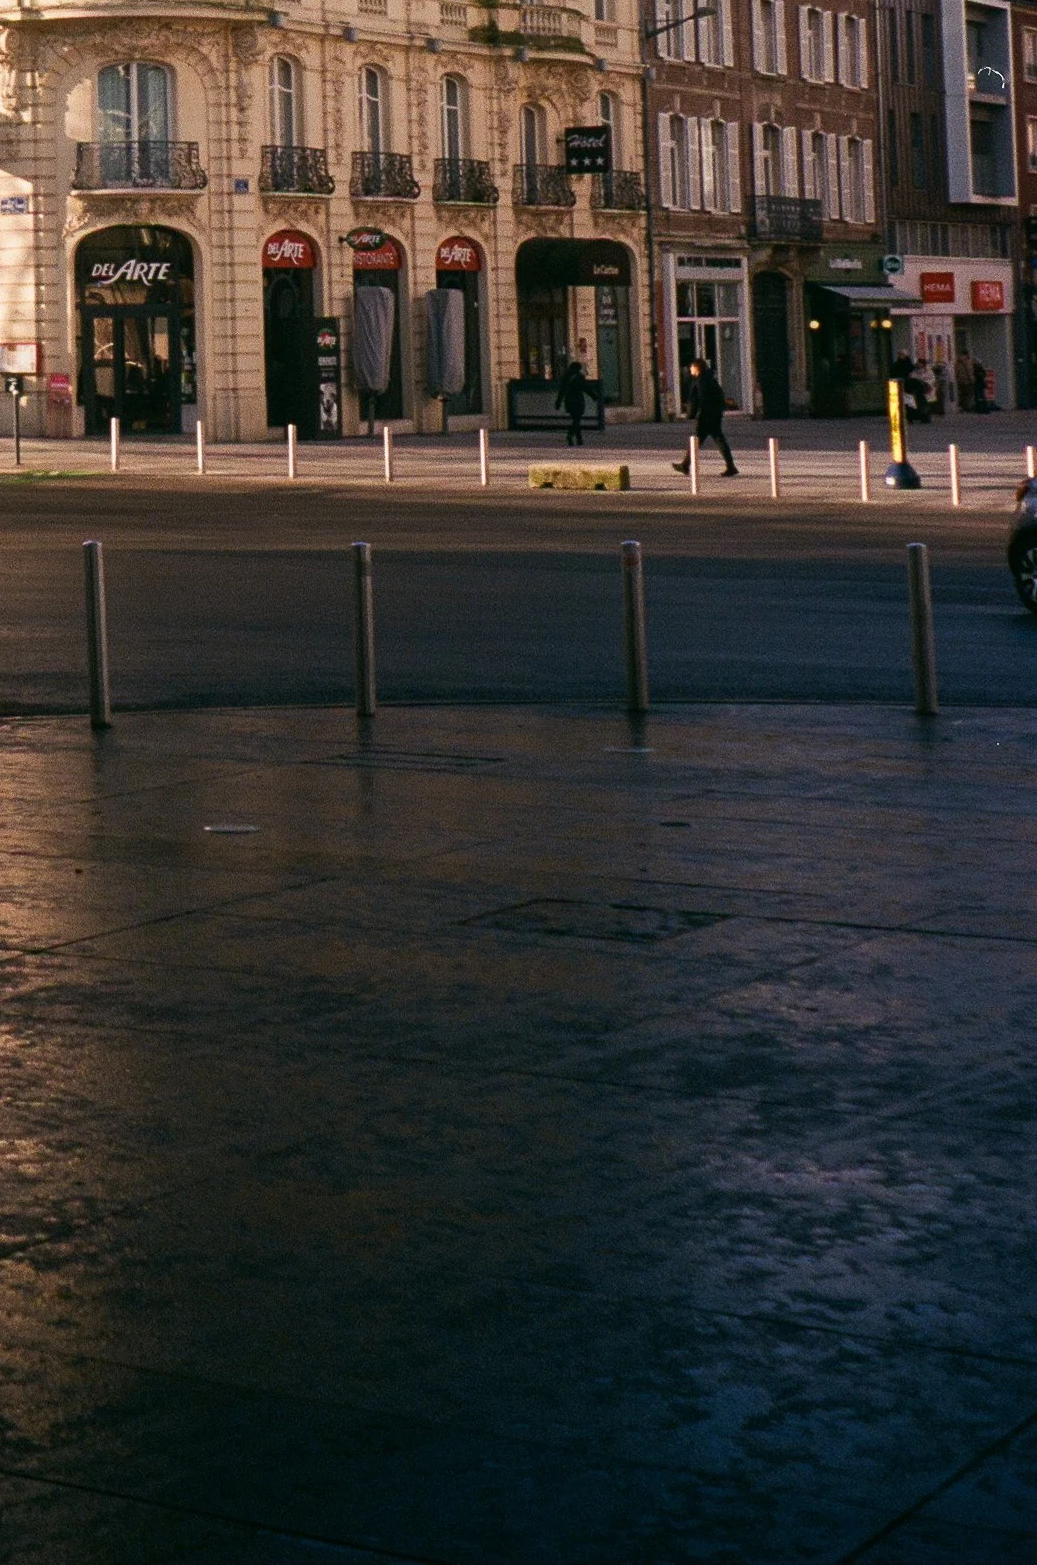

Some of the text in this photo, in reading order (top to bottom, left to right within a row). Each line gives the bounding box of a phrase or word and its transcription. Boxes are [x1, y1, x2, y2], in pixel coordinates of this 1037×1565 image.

[270, 238, 305, 265] ARTE
[442, 243, 472, 268] ARTE
[91, 258, 171, 286] DEL ARTE
[923, 282, 952, 292] HEMA
